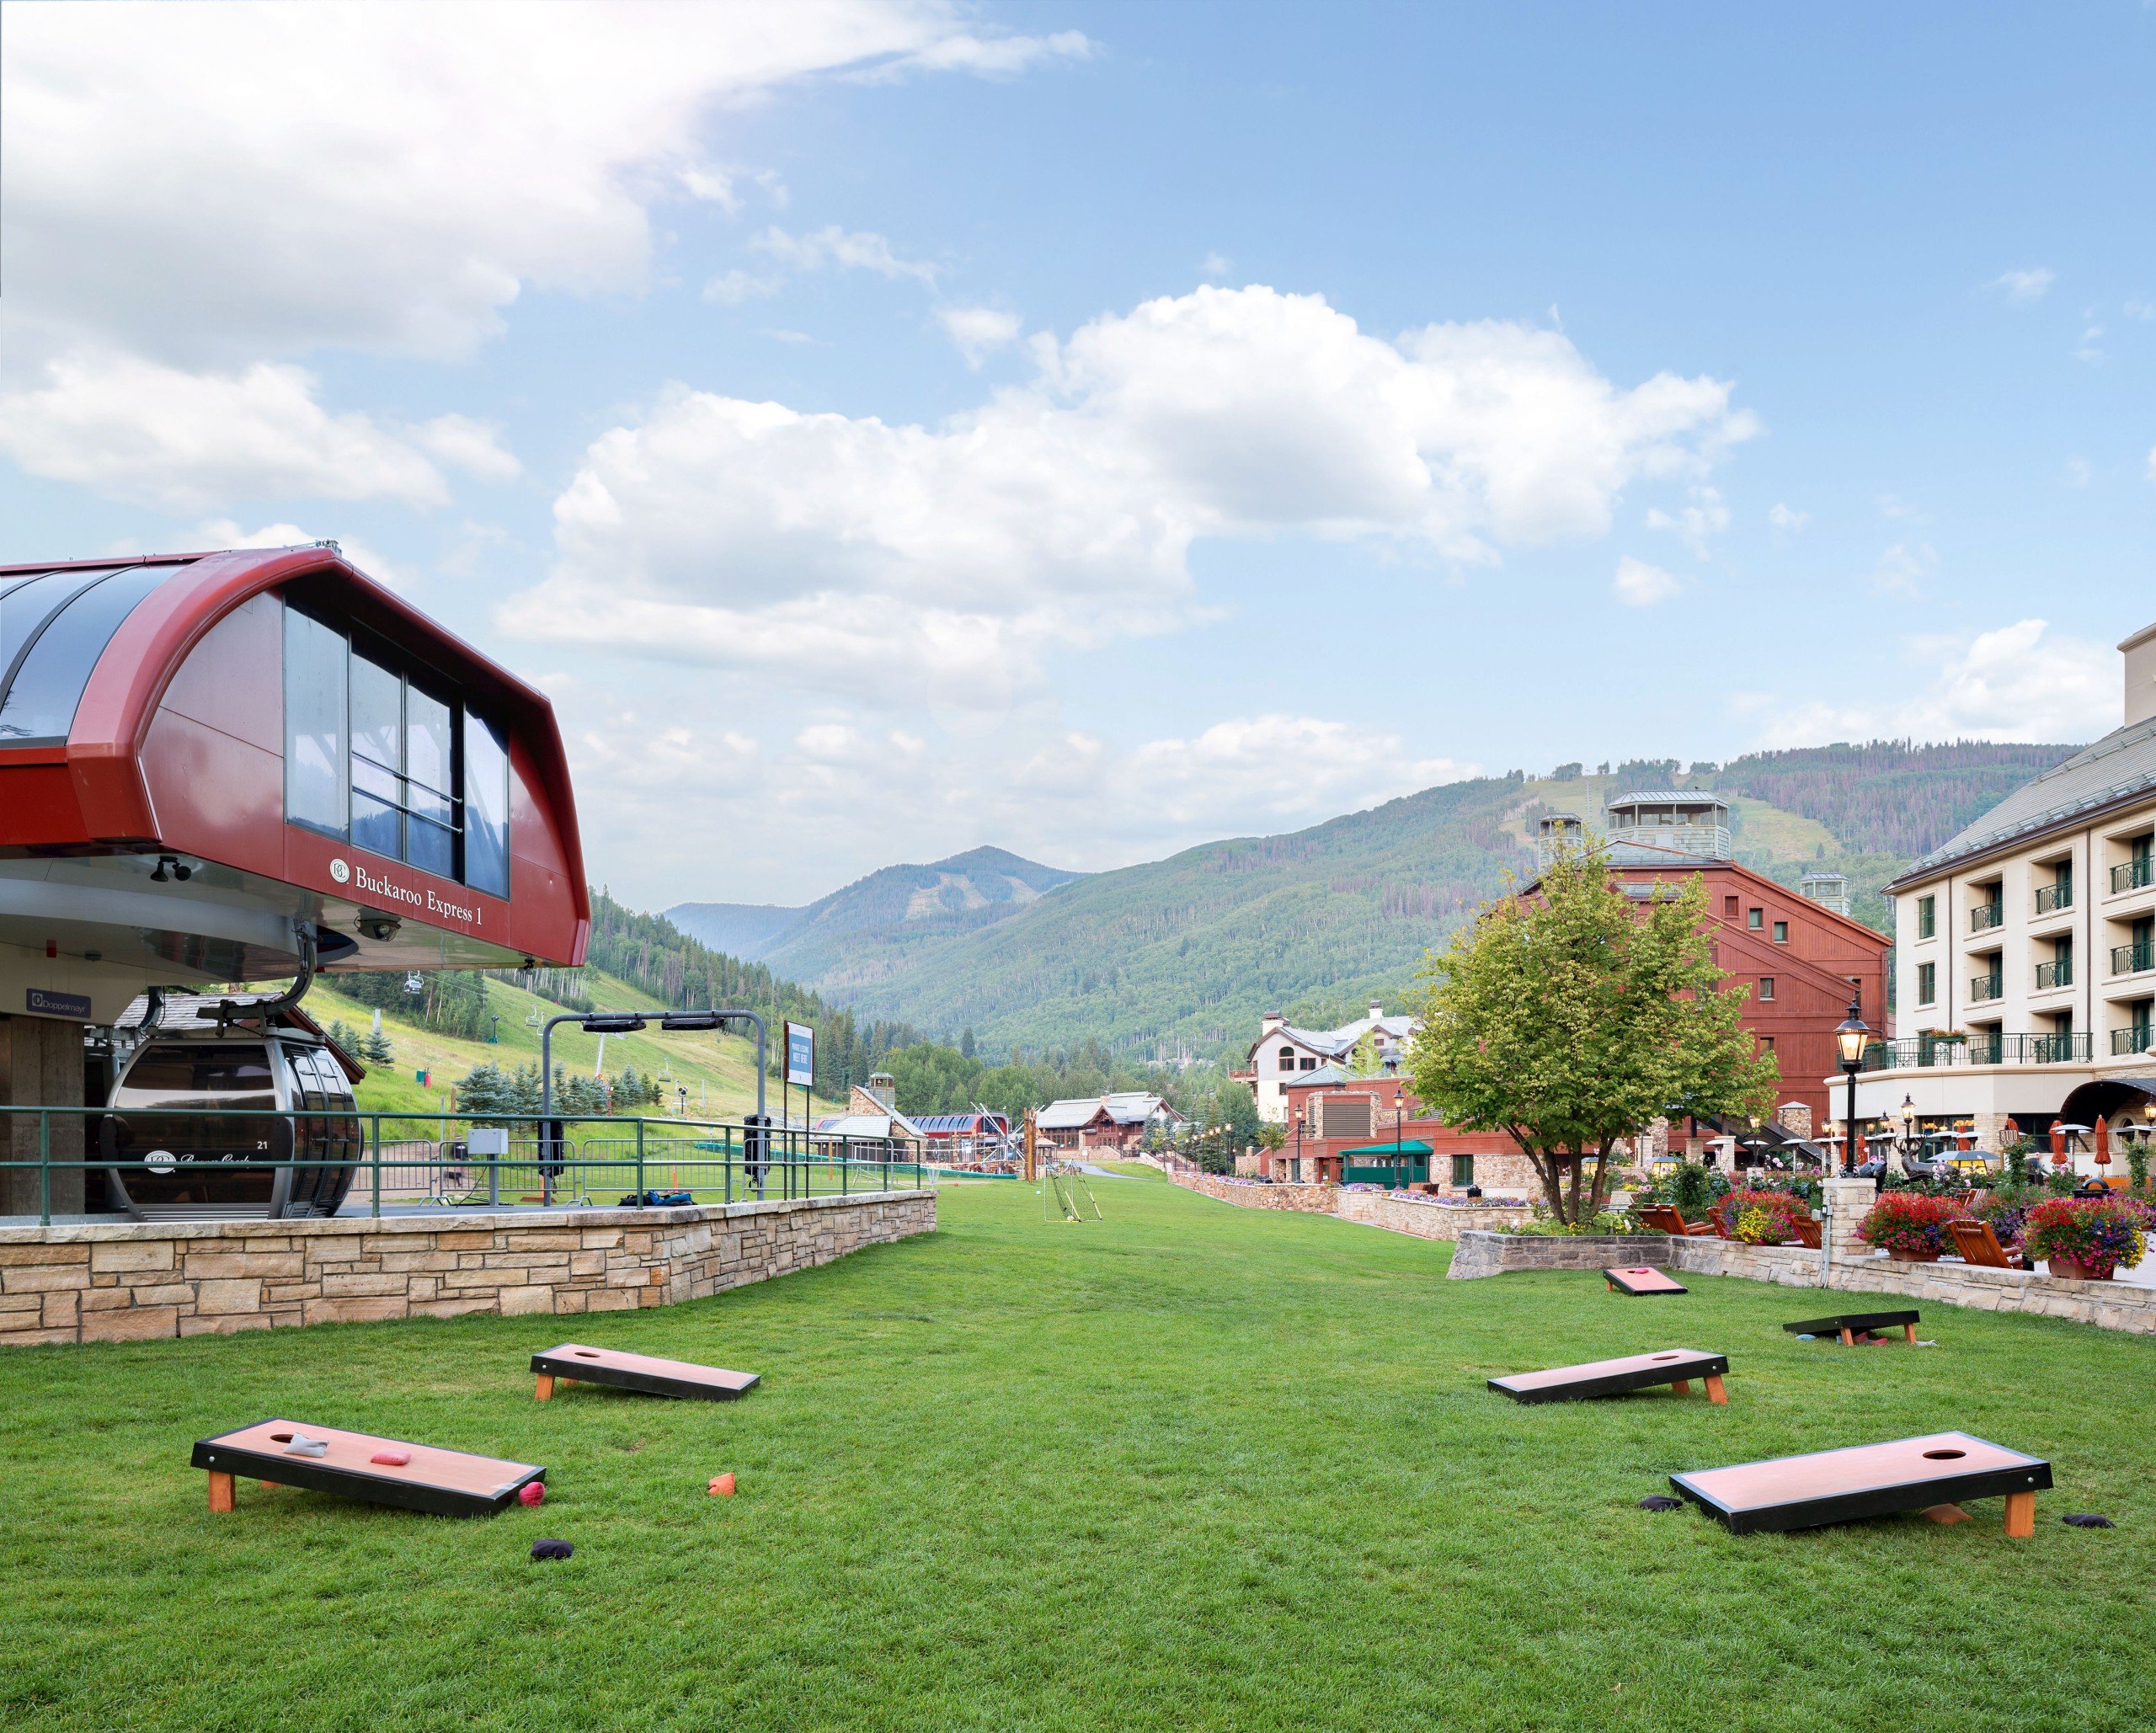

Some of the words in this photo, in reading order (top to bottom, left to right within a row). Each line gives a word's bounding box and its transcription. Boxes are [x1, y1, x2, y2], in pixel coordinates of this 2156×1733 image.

[355, 866, 422, 906] Buckaroo
[427, 889, 472, 922] Express
[476, 907, 483, 925] 1
[43, 1000, 85, 1014] Doppelmayr
[2000, 1129, 2018, 1142] 8100
[257, 1141, 268, 1149] 21
